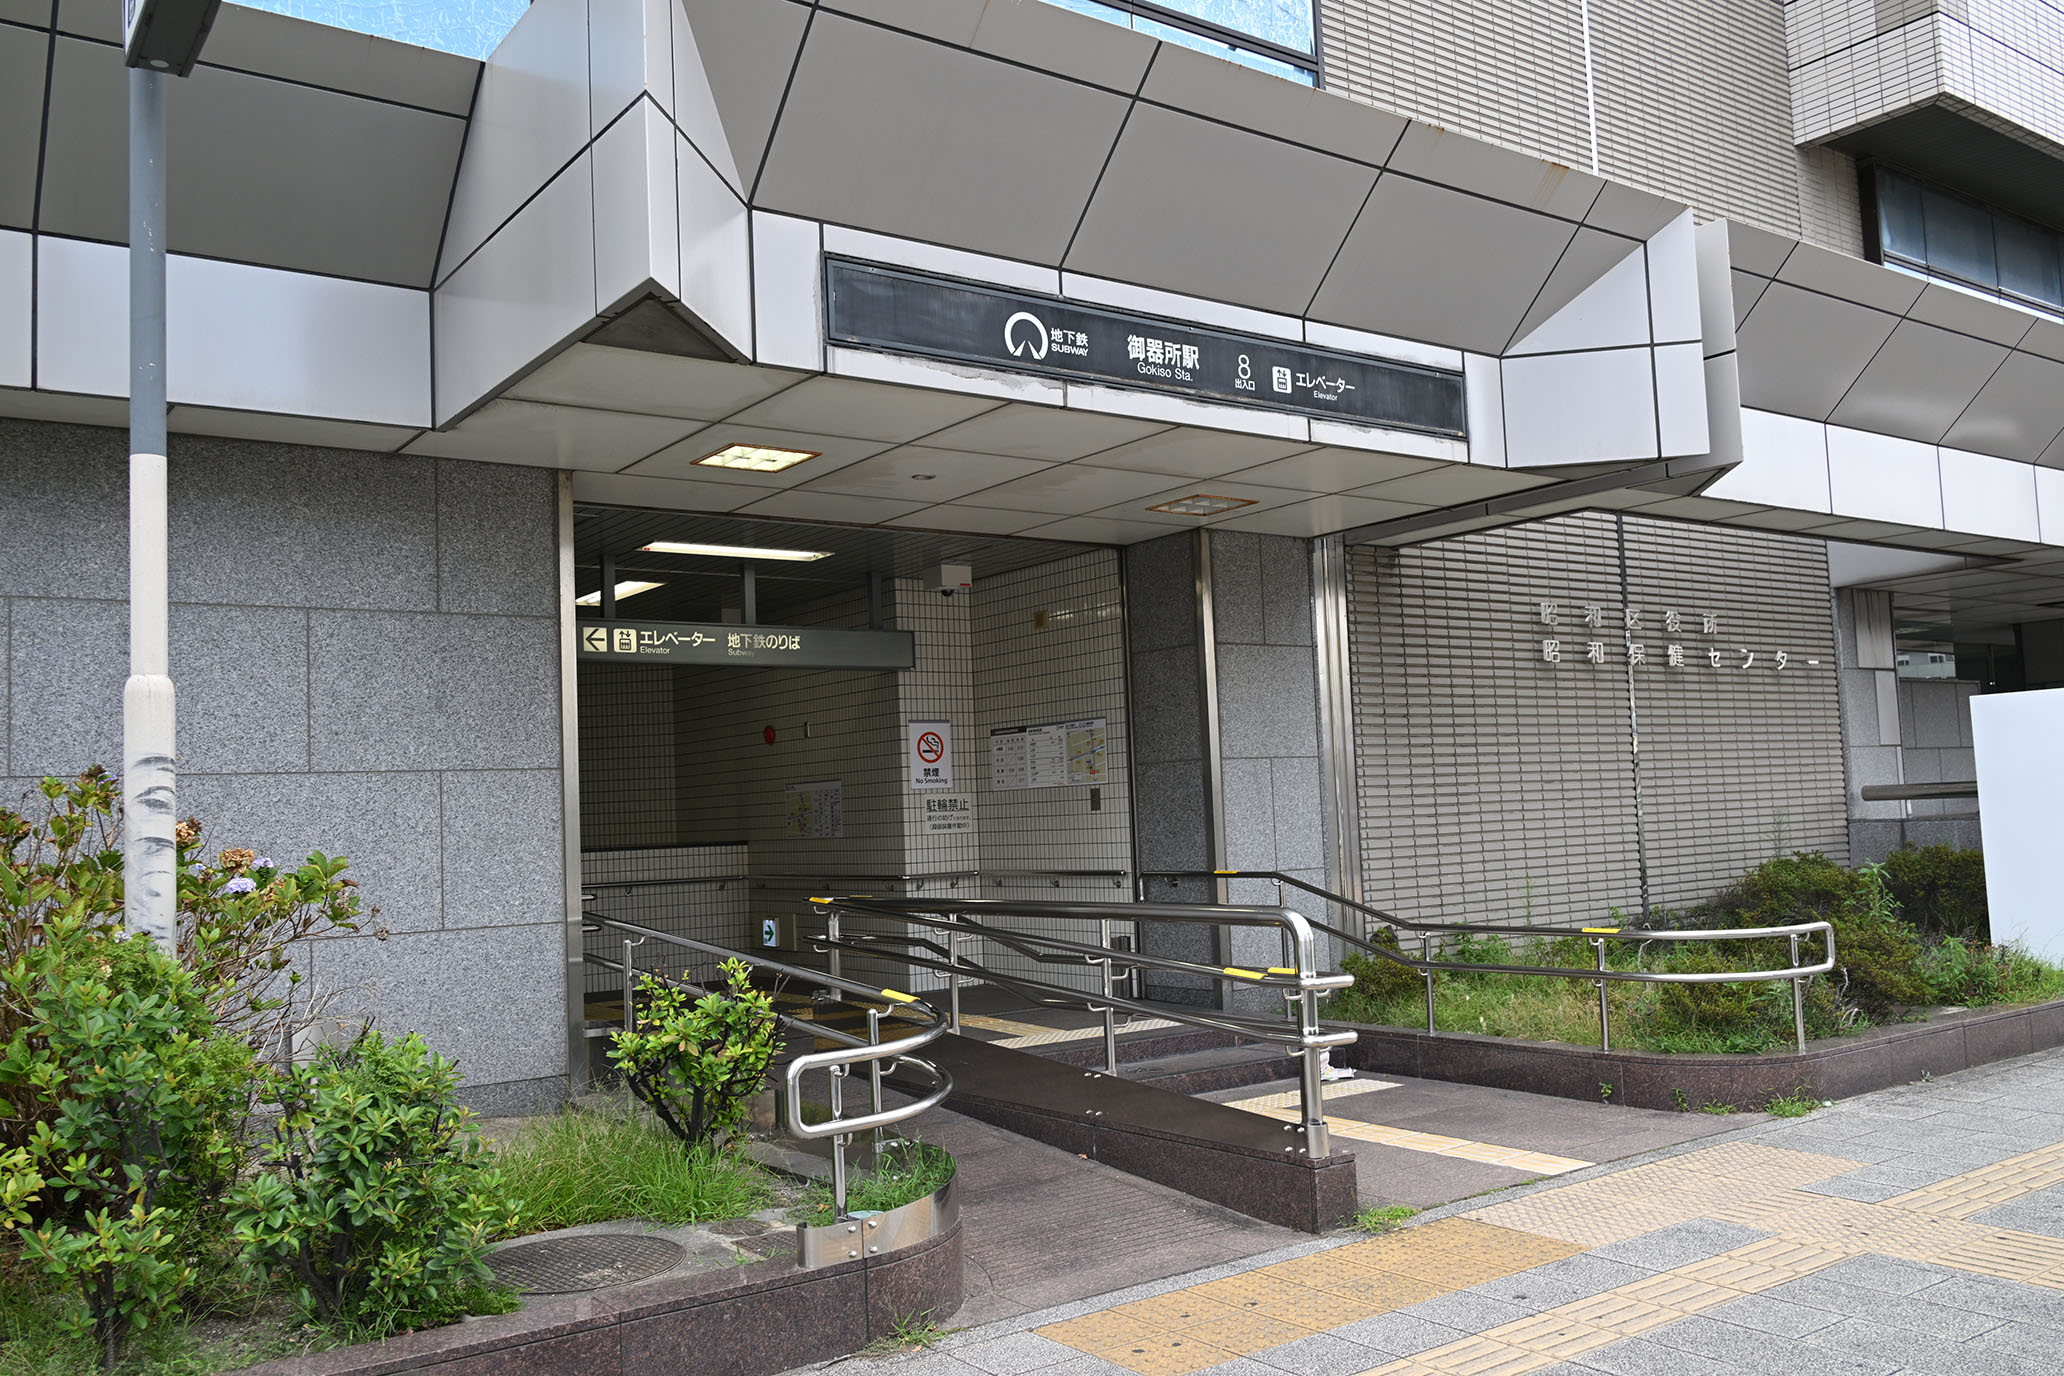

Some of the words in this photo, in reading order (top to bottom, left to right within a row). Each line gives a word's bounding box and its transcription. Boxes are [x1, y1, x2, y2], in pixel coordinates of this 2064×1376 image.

[1050, 327, 1089, 347] 地下鉄
[1051, 343, 1089, 357] SUBWAY
[1127, 334, 1200, 370] 御器所駅
[1137, 362, 1172, 378] Gokiso
[1175, 367, 1194, 382] Sta.
[1237, 354, 1251, 380] 8
[1234, 378, 1256, 391] 出入口
[1295, 372, 1356, 393] エレベーター
[1313, 390, 1338, 401] Elevator
[1540, 602, 1718, 634] 昭和区役所
[640, 630, 716, 647] エレベーター
[727, 632, 801, 650] 地下鉄のりば
[640, 646, 671, 655] Elevator
[727, 648, 755, 658] Subway
[1543, 639, 1820, 670] 昭和保健センター
[915, 777, 924, 785] No
[924, 777, 948, 785] Smoking
[923, 767, 940, 778] 禁煙
[926, 798, 970, 812] 駐輪禁止
